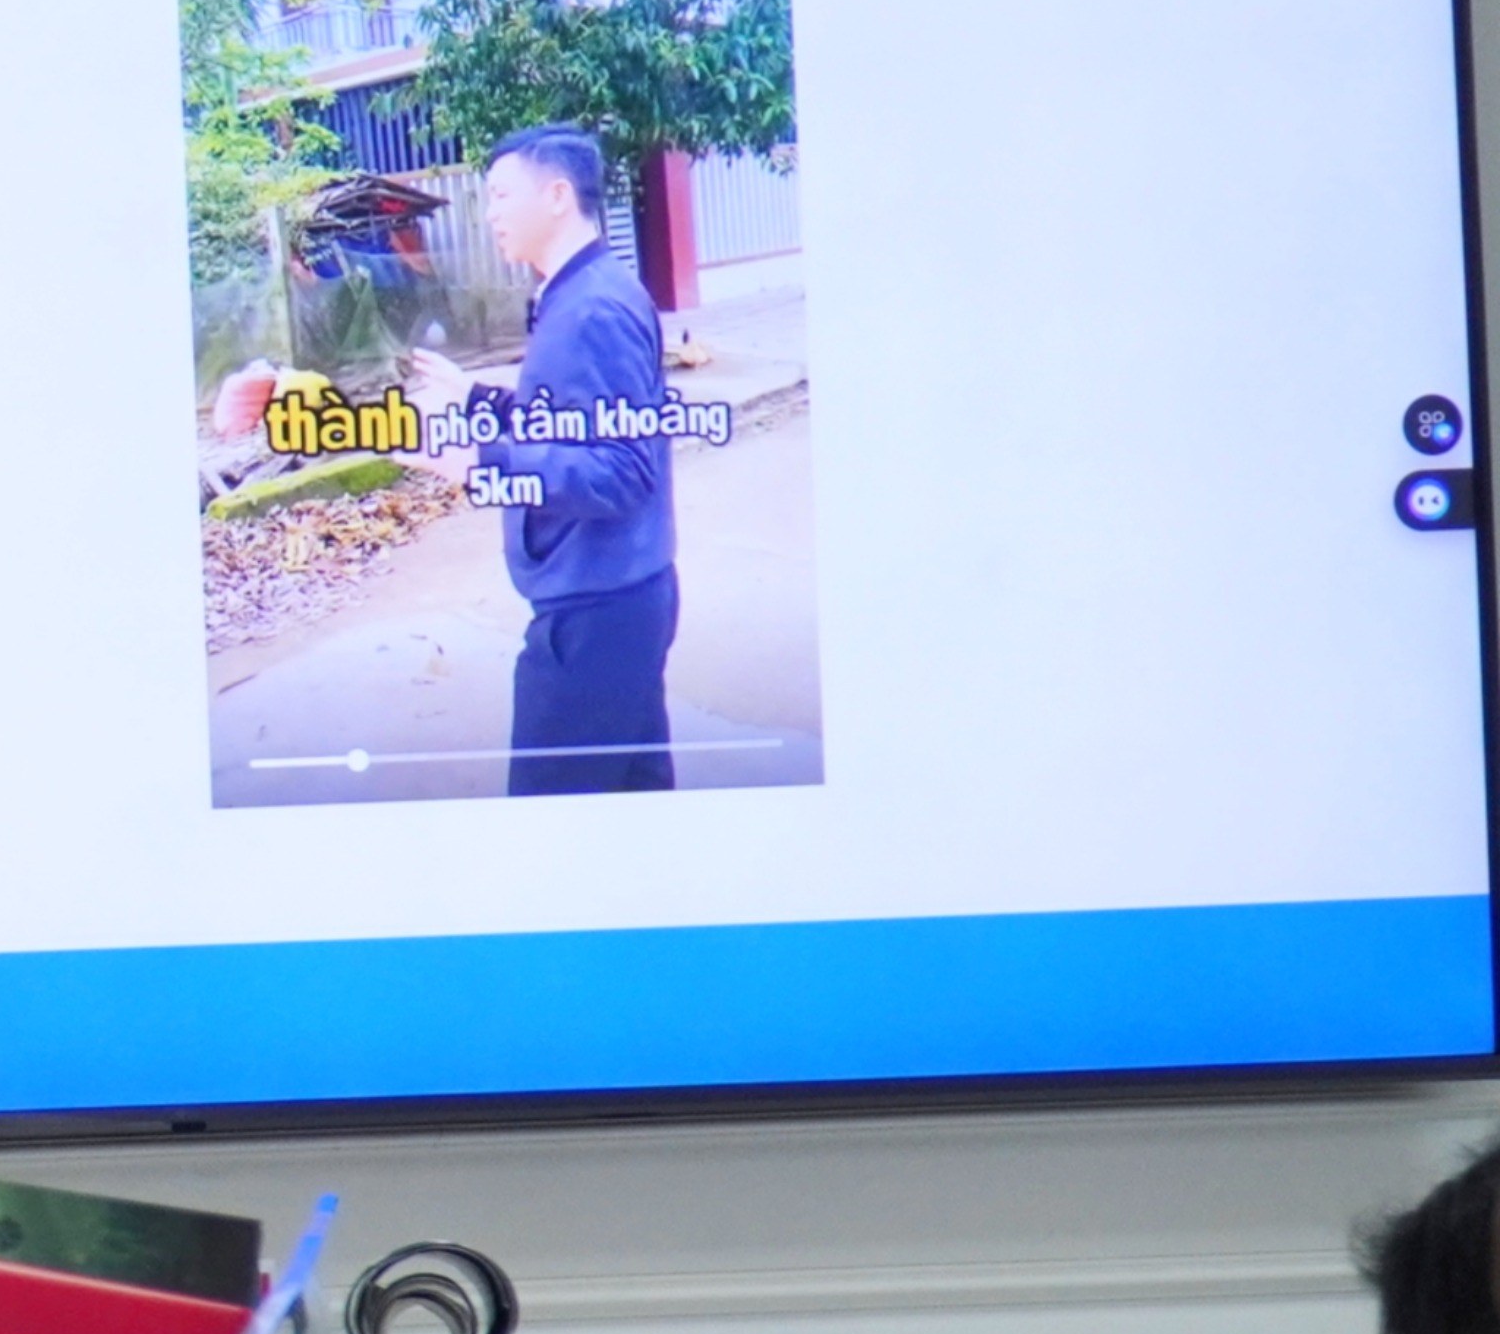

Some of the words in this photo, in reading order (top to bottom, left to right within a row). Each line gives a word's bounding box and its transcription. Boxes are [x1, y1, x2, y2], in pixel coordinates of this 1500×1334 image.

[266, 390, 420, 454] thành
[429, 388, 501, 455] phố
[510, 387, 586, 442] tầm
[596, 387, 730, 445] khoảng
[468, 466, 544, 507] 5km
